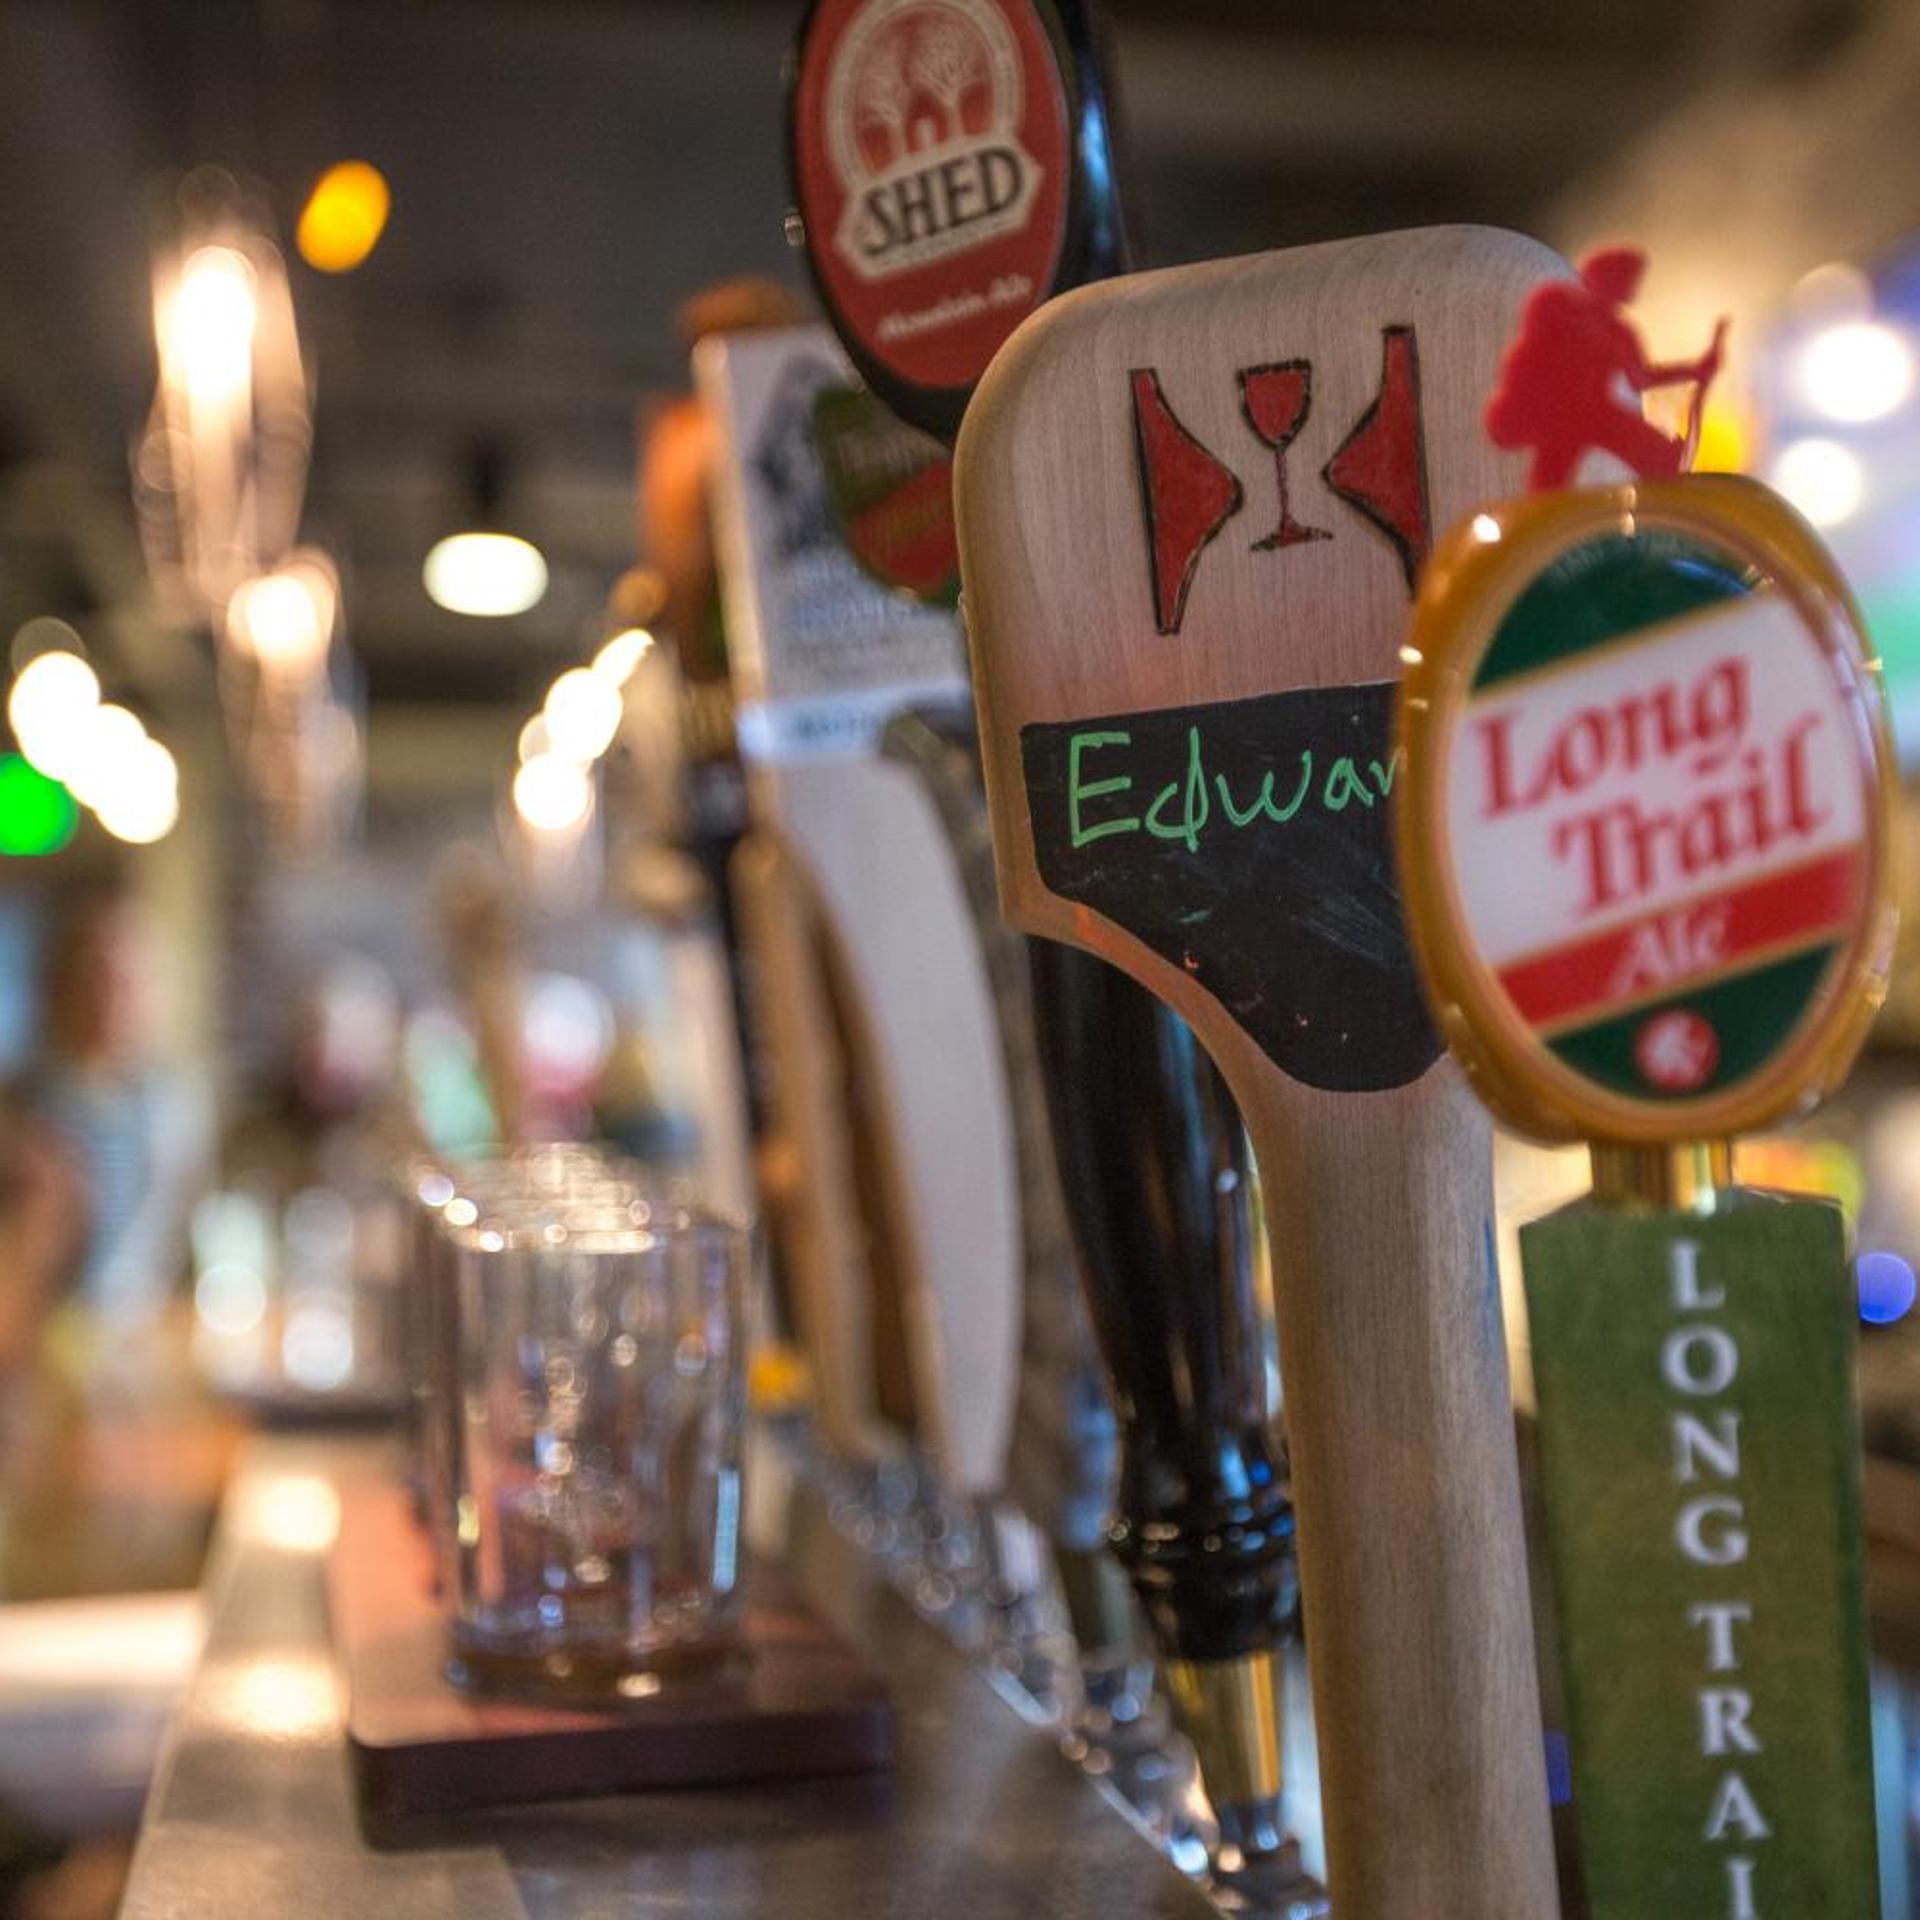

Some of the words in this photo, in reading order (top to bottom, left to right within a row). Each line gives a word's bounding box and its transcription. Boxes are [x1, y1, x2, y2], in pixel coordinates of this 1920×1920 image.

[861, 146, 1027, 256] SHED
[1473, 653, 1751, 821] Long
[1550, 710, 1830, 915] Trail
[1612, 902, 1728, 996] Ale
[1660, 1238, 1750, 1567] LONG
